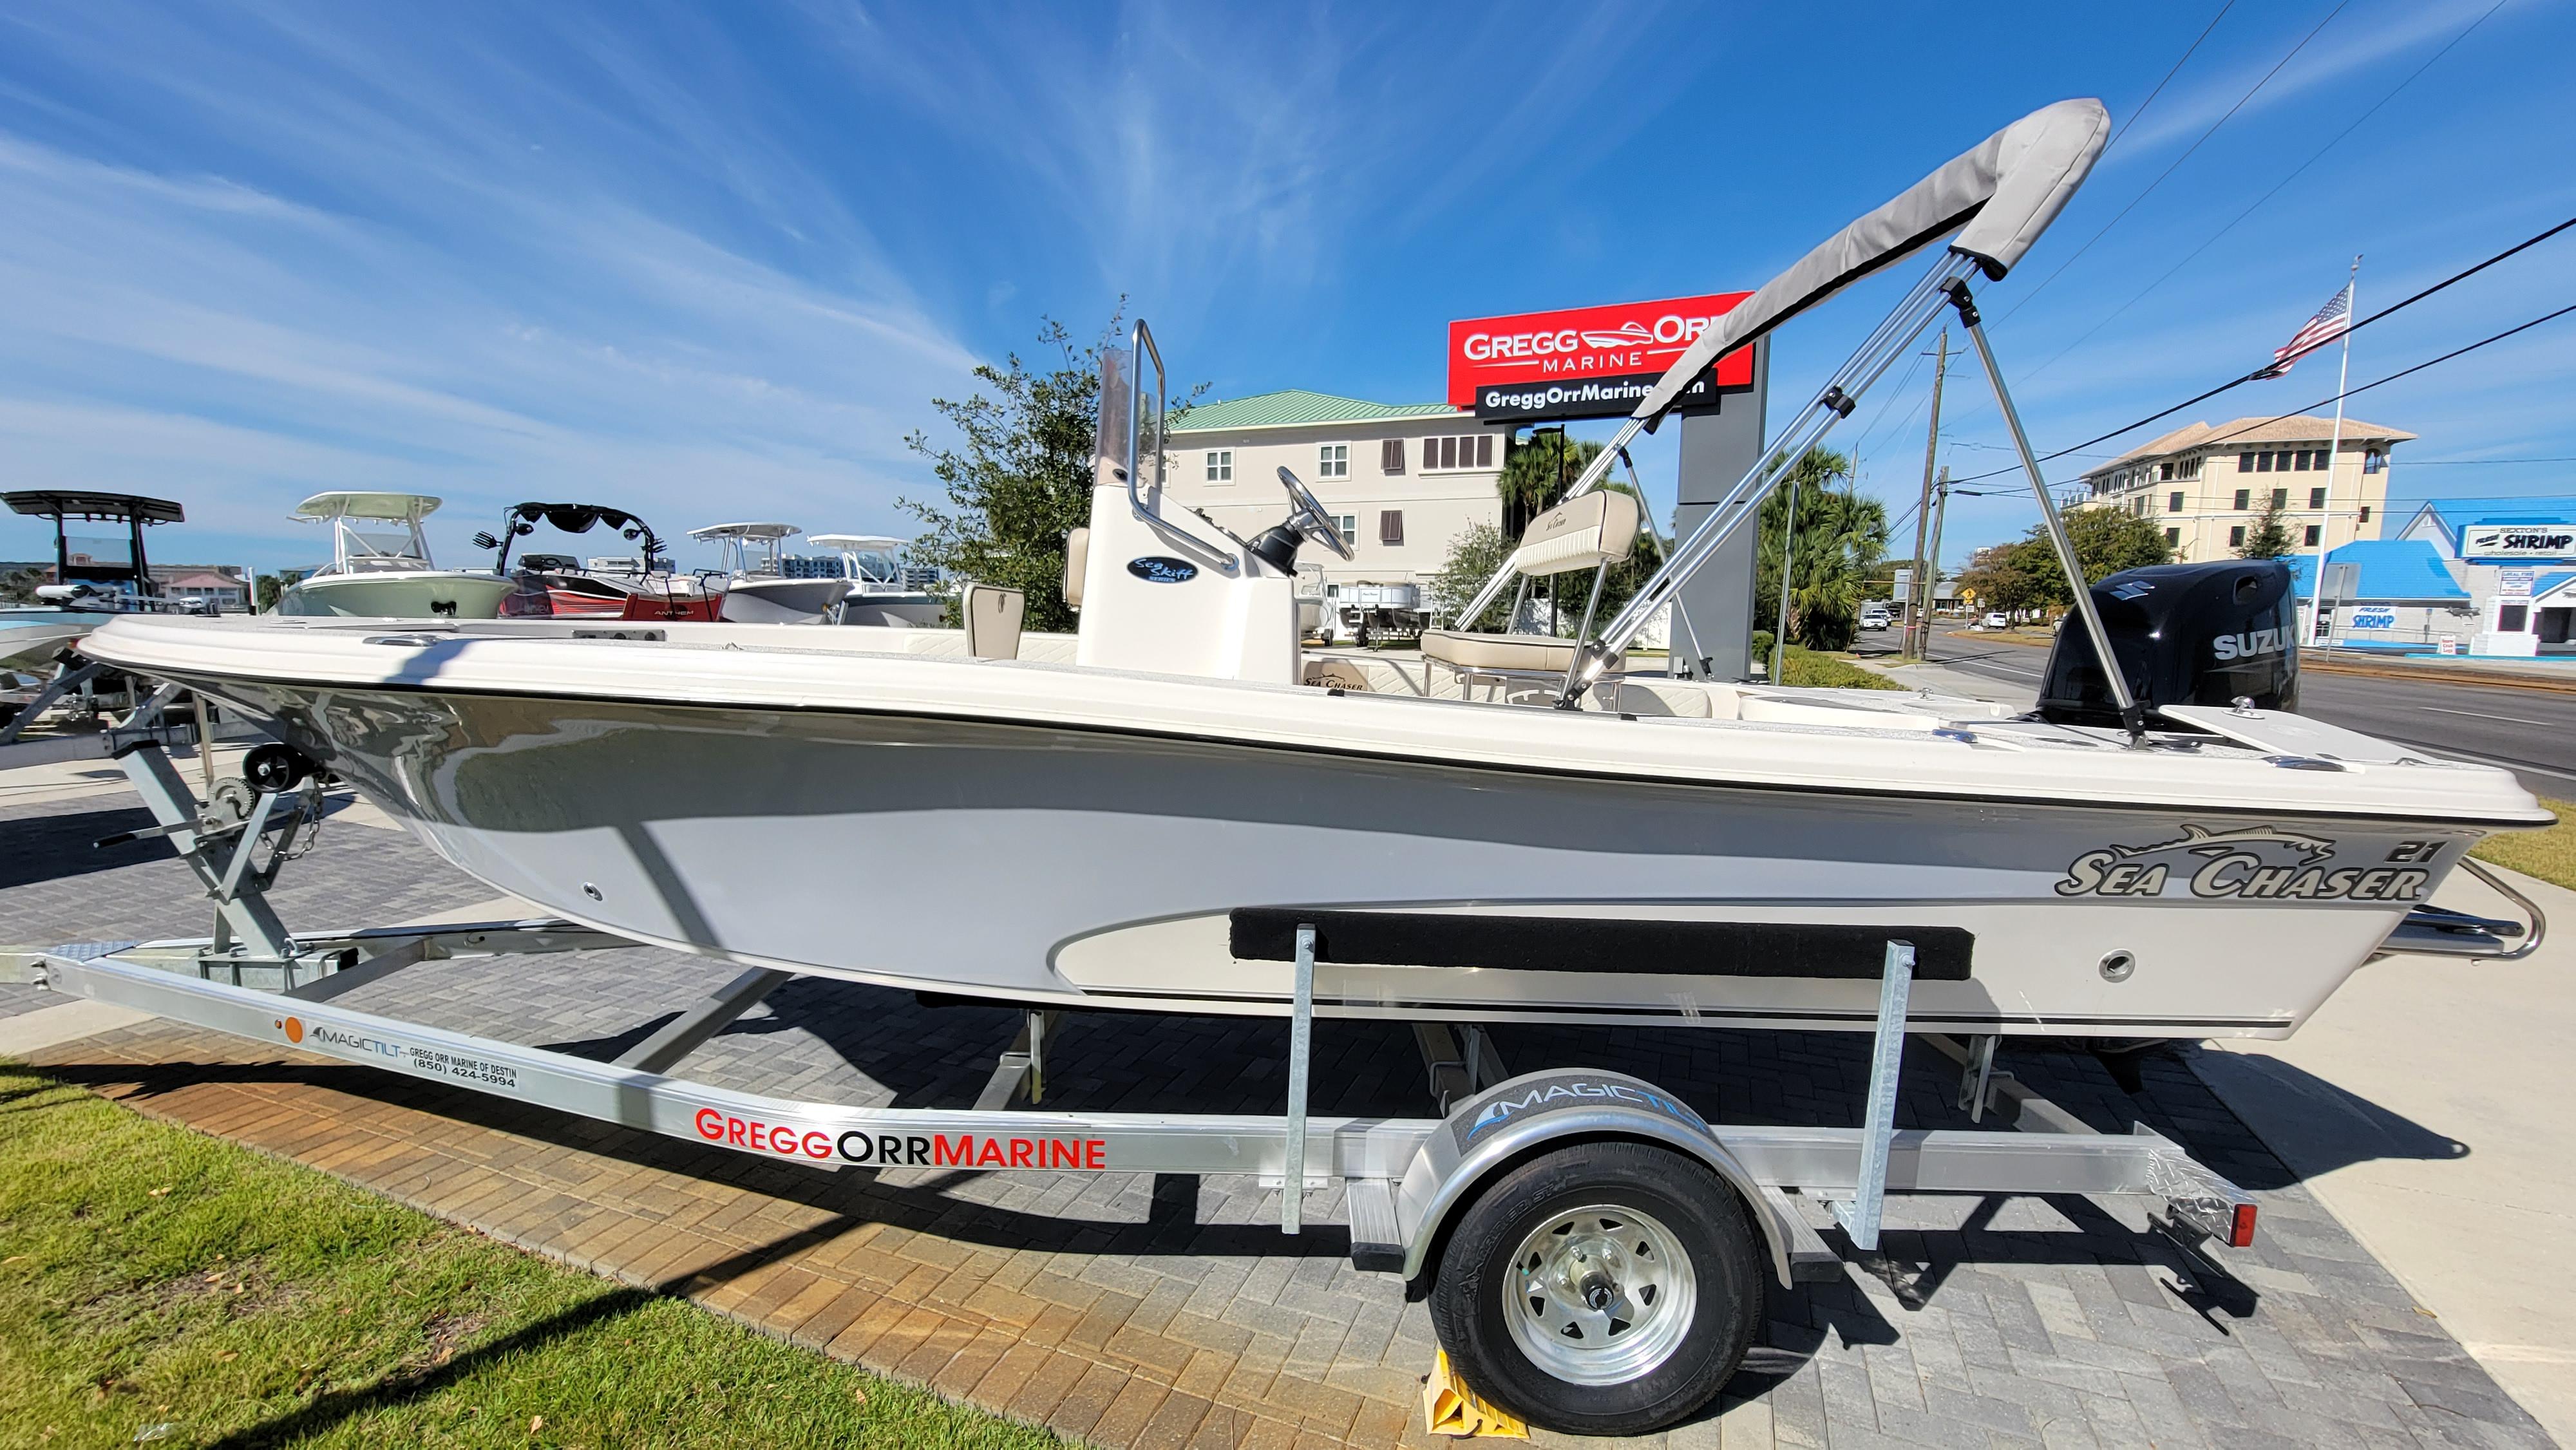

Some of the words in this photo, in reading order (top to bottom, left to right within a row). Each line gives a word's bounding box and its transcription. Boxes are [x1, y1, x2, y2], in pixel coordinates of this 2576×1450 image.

[1464, 330, 1578, 360] GREGG
[1653, 315, 1717, 343] OR
[1542, 352, 1643, 373] MARINE
[2503, 534, 2573, 549] SHRIMP
[1150, 567, 1194, 579] Skiff
[2353, 614, 2394, 628] SHRIMP
[2383, 840, 2449, 864] 21
[410, 1047, 433, 1060] GREGG
[435, 1053, 450, 1064] ORR
[451, 1056, 478, 1071] MARINE
[480, 1062, 489, 1073] OF
[491, 1064, 517, 1079] DESTIN
[413, 1058, 447, 1075] (850)
[451, 1068, 516, 1088] 424-5994
